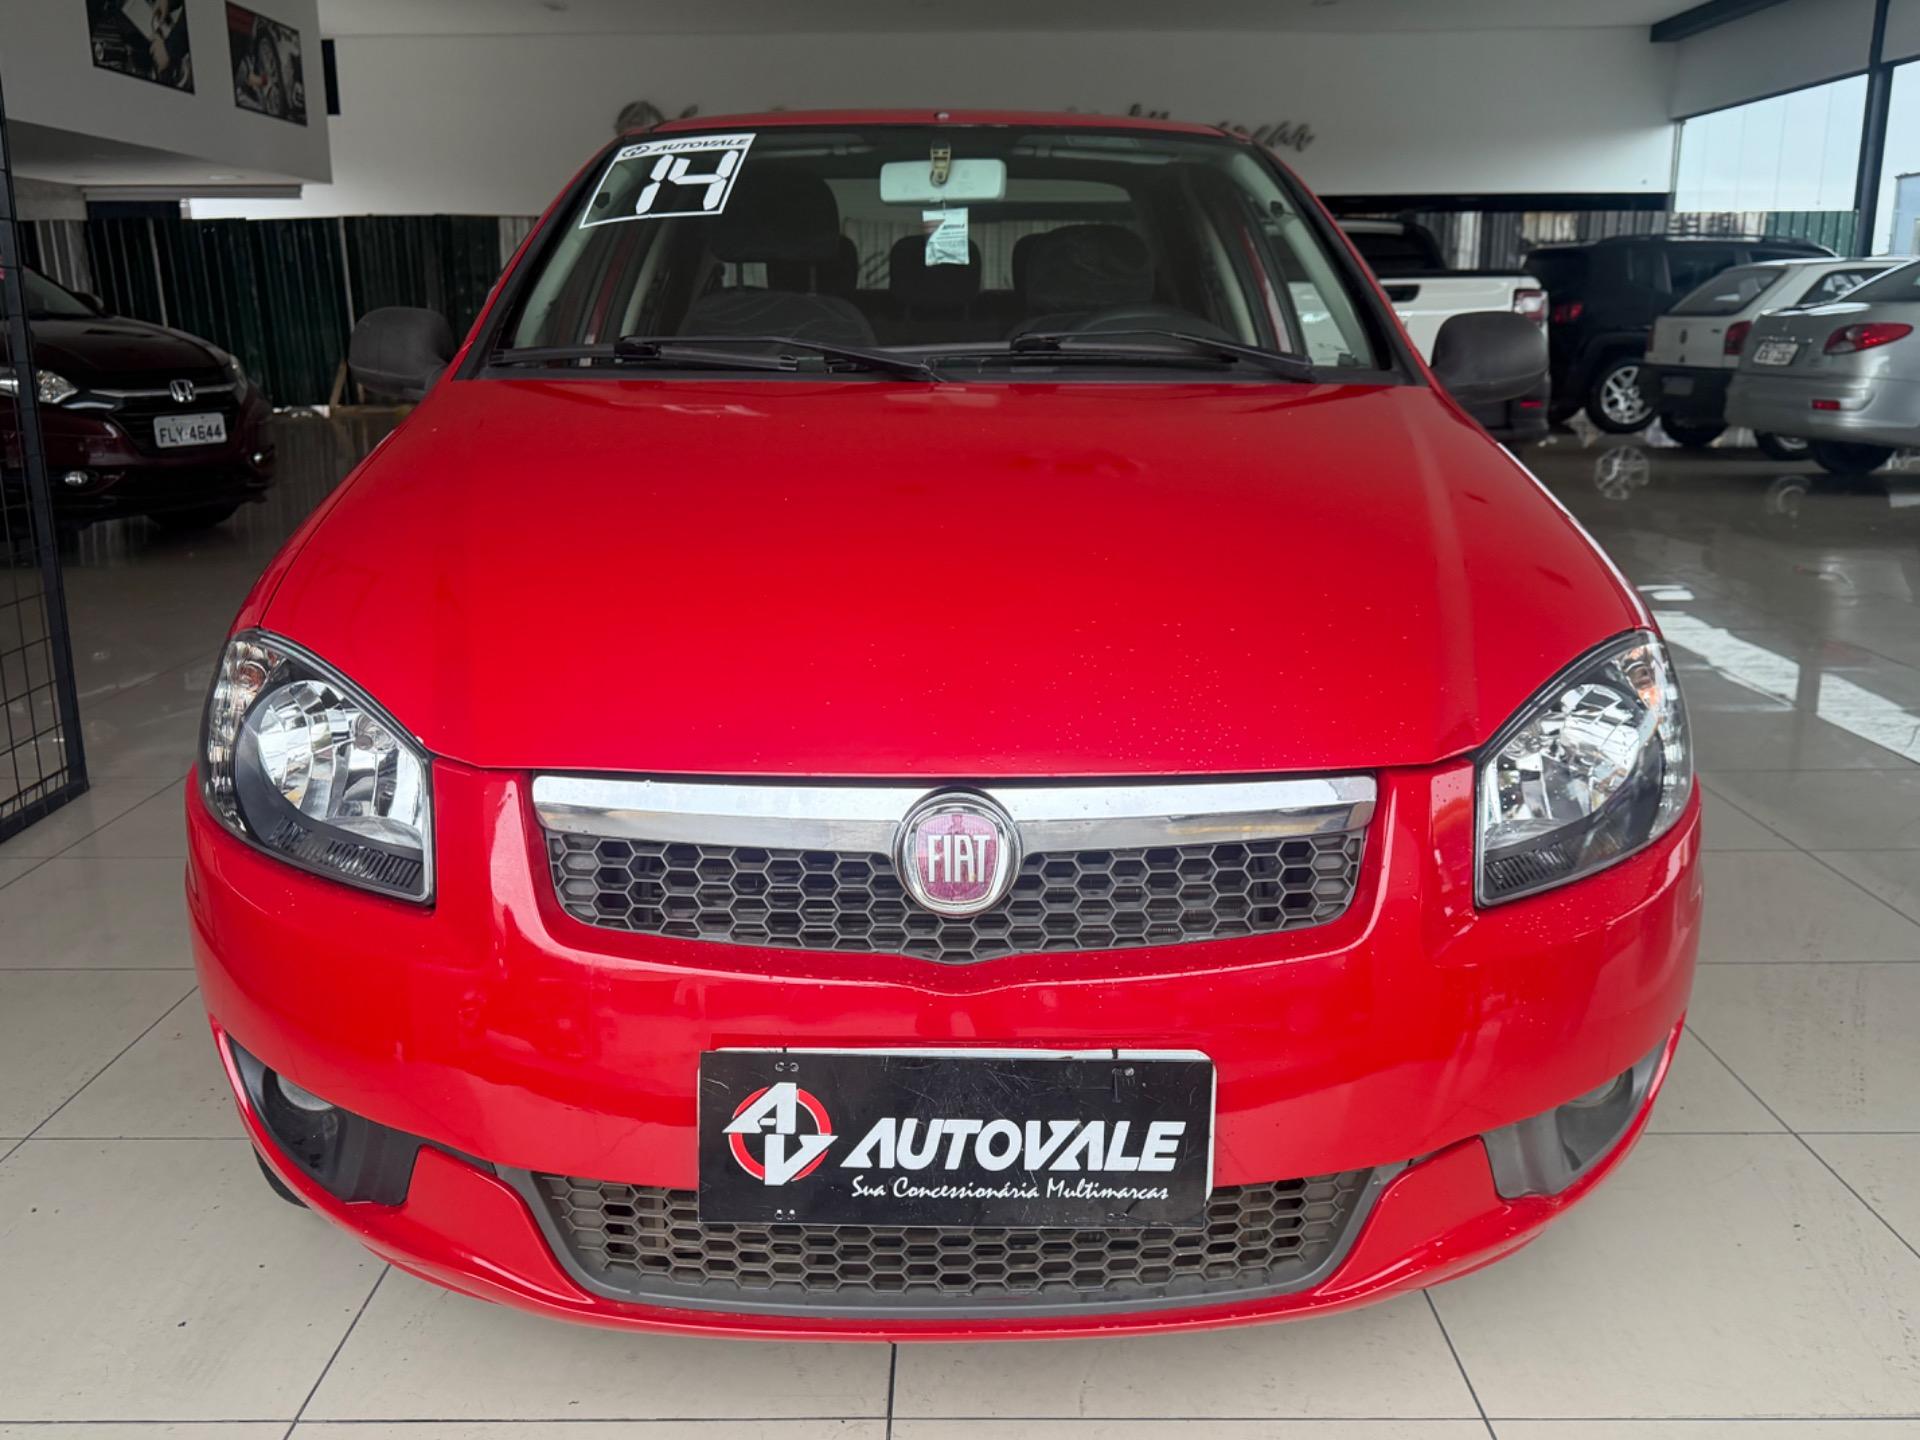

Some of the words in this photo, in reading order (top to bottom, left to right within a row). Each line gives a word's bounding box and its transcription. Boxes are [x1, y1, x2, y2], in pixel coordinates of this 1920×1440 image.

[653, 138, 749, 152] AUTOVALE
[635, 150, 739, 214] 14
[927, 834, 991, 883] FIAT
[840, 1118, 1186, 1171] AUTOVALE
[851, 1175, 886, 1197] Sua
[893, 1177, 1039, 1199] Concessionária
[1046, 1177, 1169, 1200] Multimarcas
